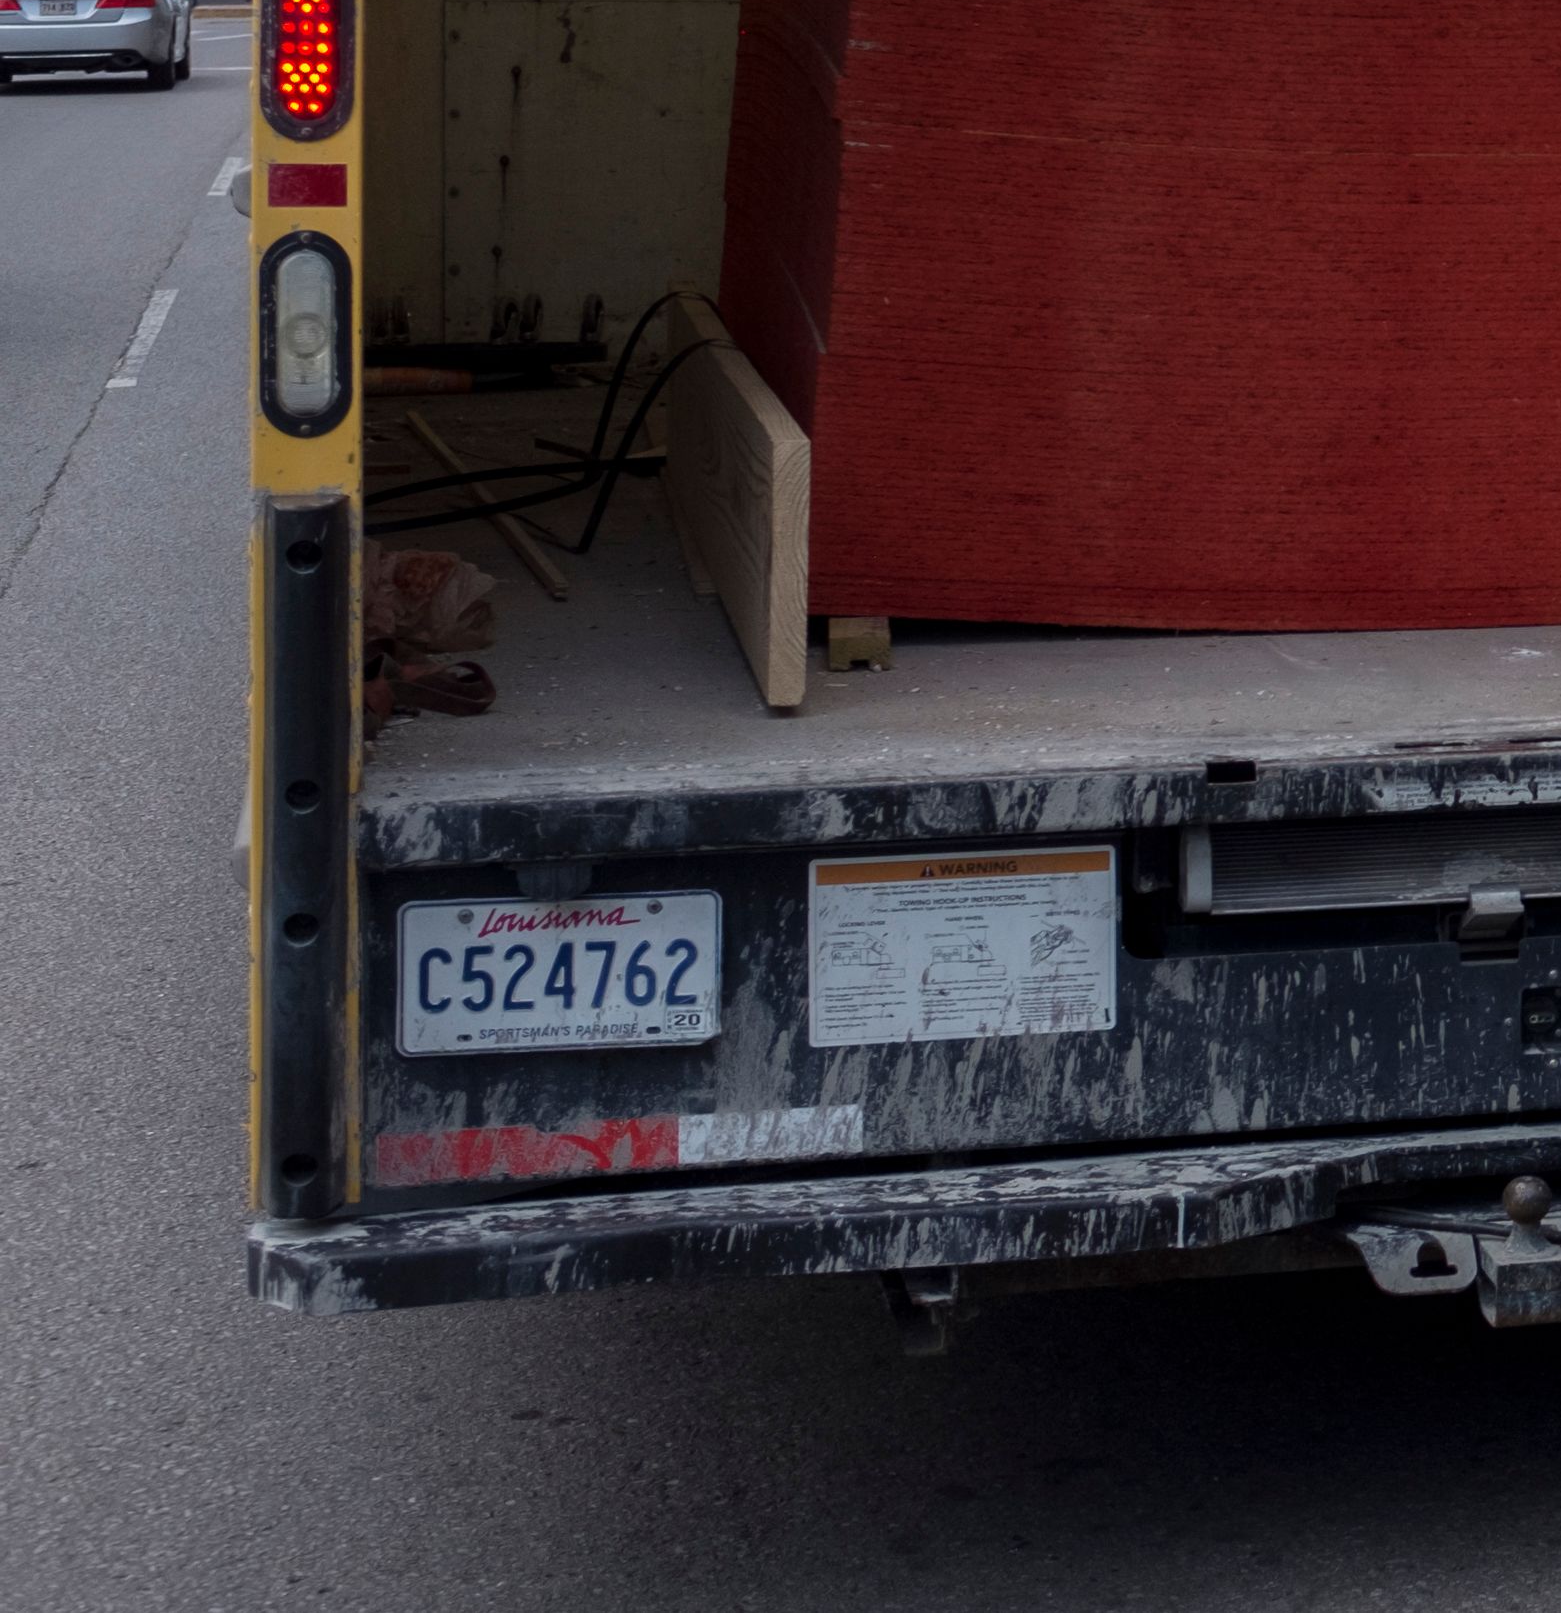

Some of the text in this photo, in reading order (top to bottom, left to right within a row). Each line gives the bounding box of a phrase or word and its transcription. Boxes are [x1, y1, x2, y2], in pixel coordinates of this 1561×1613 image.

[939, 862, 1018, 876] WARNING
[477, 907, 641, 938] Louisiana
[419, 938, 698, 1014] C524762
[673, 1013, 701, 1026] 20
[479, 1022, 638, 1039] SPORTSMAN'S PARADISE
